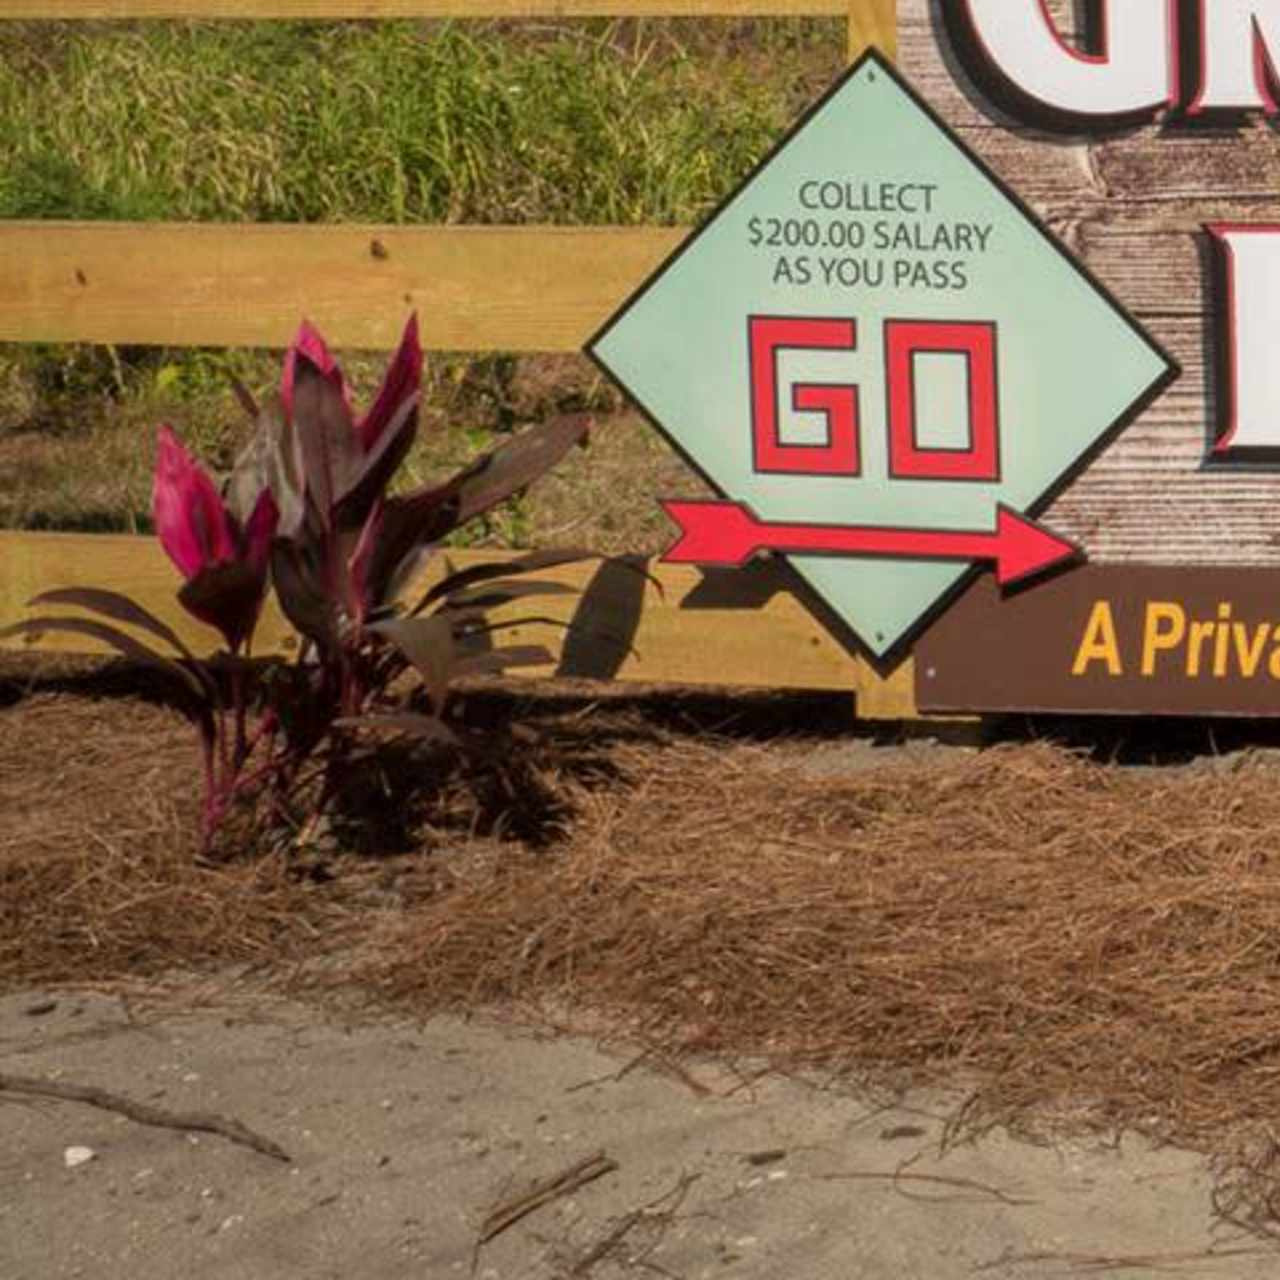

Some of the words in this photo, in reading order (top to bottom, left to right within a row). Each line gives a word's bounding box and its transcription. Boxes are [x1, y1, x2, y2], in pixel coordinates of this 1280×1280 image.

[799, 180, 938, 213] COLLECT
[748, 217, 865, 249] $200.00
[873, 221, 993, 252] SALARY
[772, 256, 812, 285] AS
[819, 258, 884, 287] YOU
[893, 260, 968, 290] PASS
[746, 314, 1002, 482] GO
[1071, 601, 1122, 676] A
